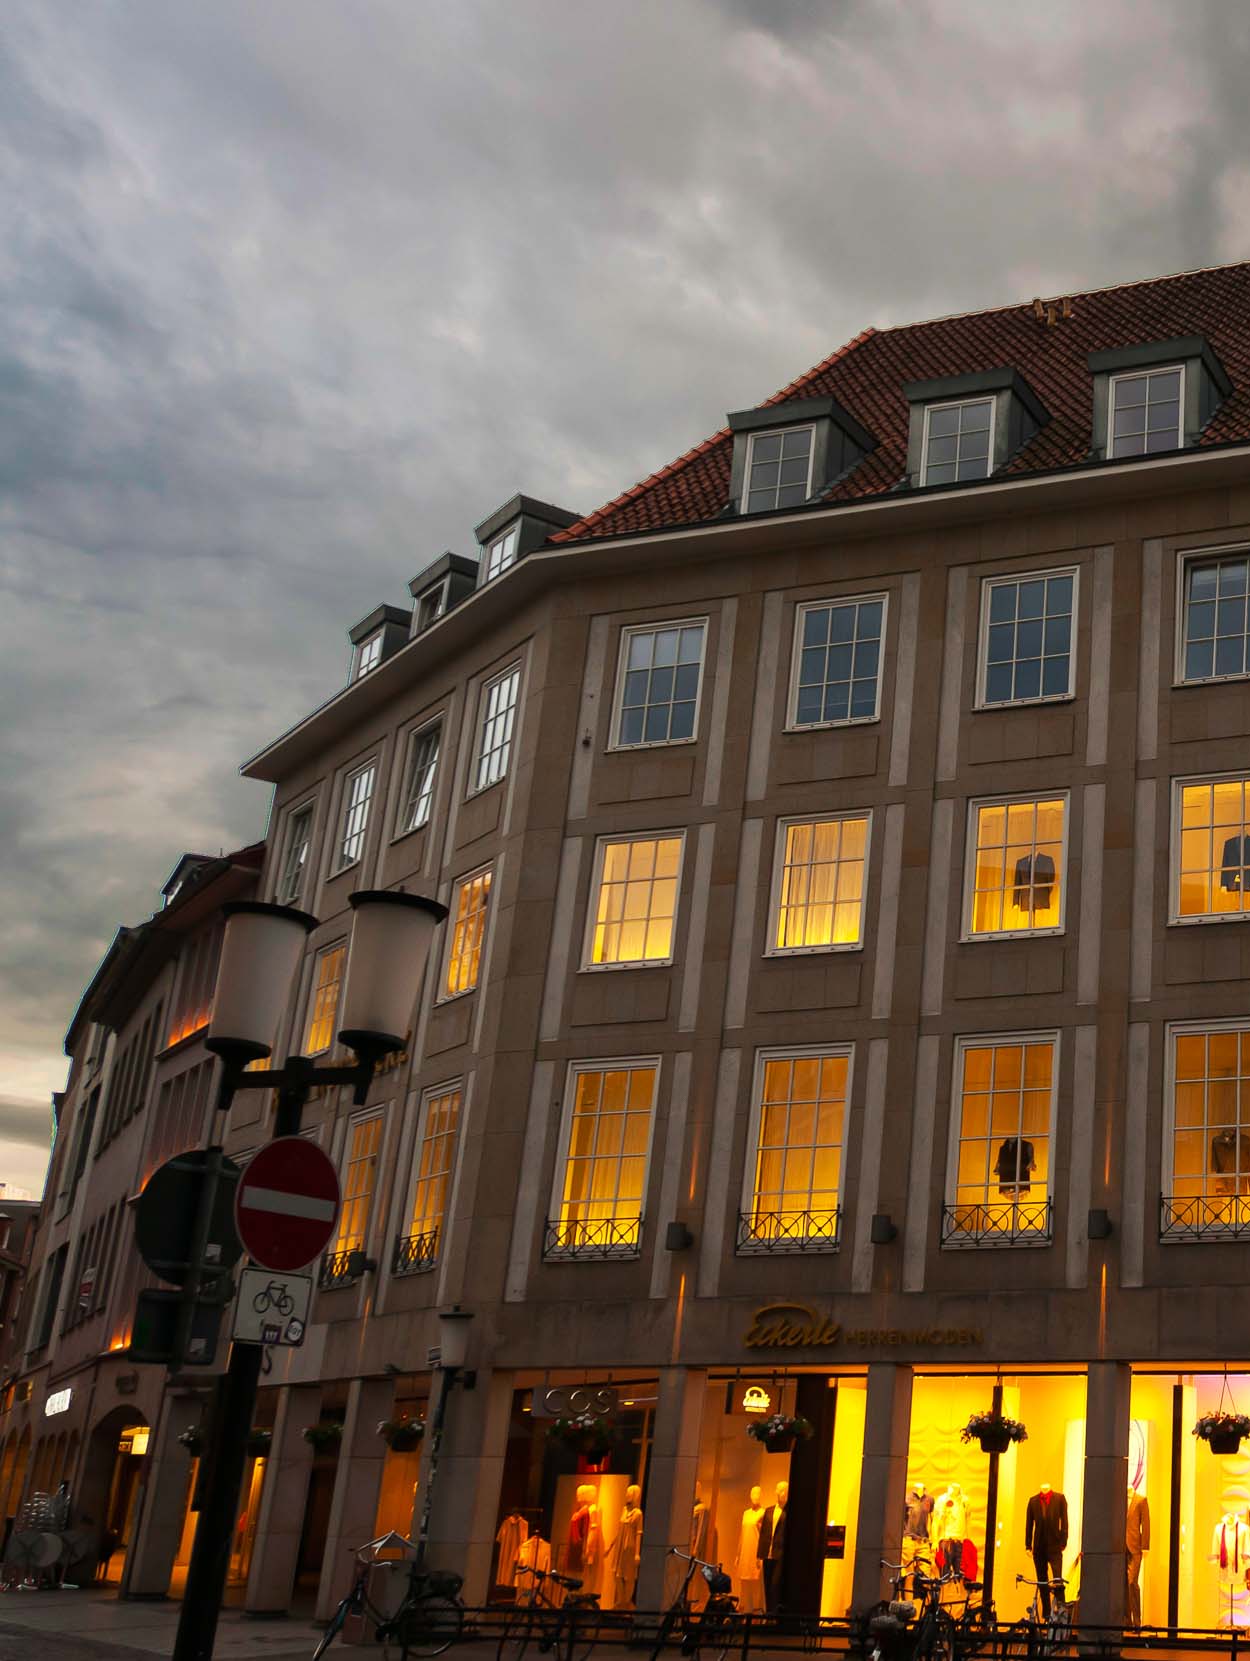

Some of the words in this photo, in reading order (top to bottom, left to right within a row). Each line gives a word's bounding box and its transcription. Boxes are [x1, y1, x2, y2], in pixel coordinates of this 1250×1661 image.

[744, 1302, 841, 1347] Eckerle
[844, 1326, 984, 1346] HERRENMODEN
[543, 1388, 611, 1414] COS
